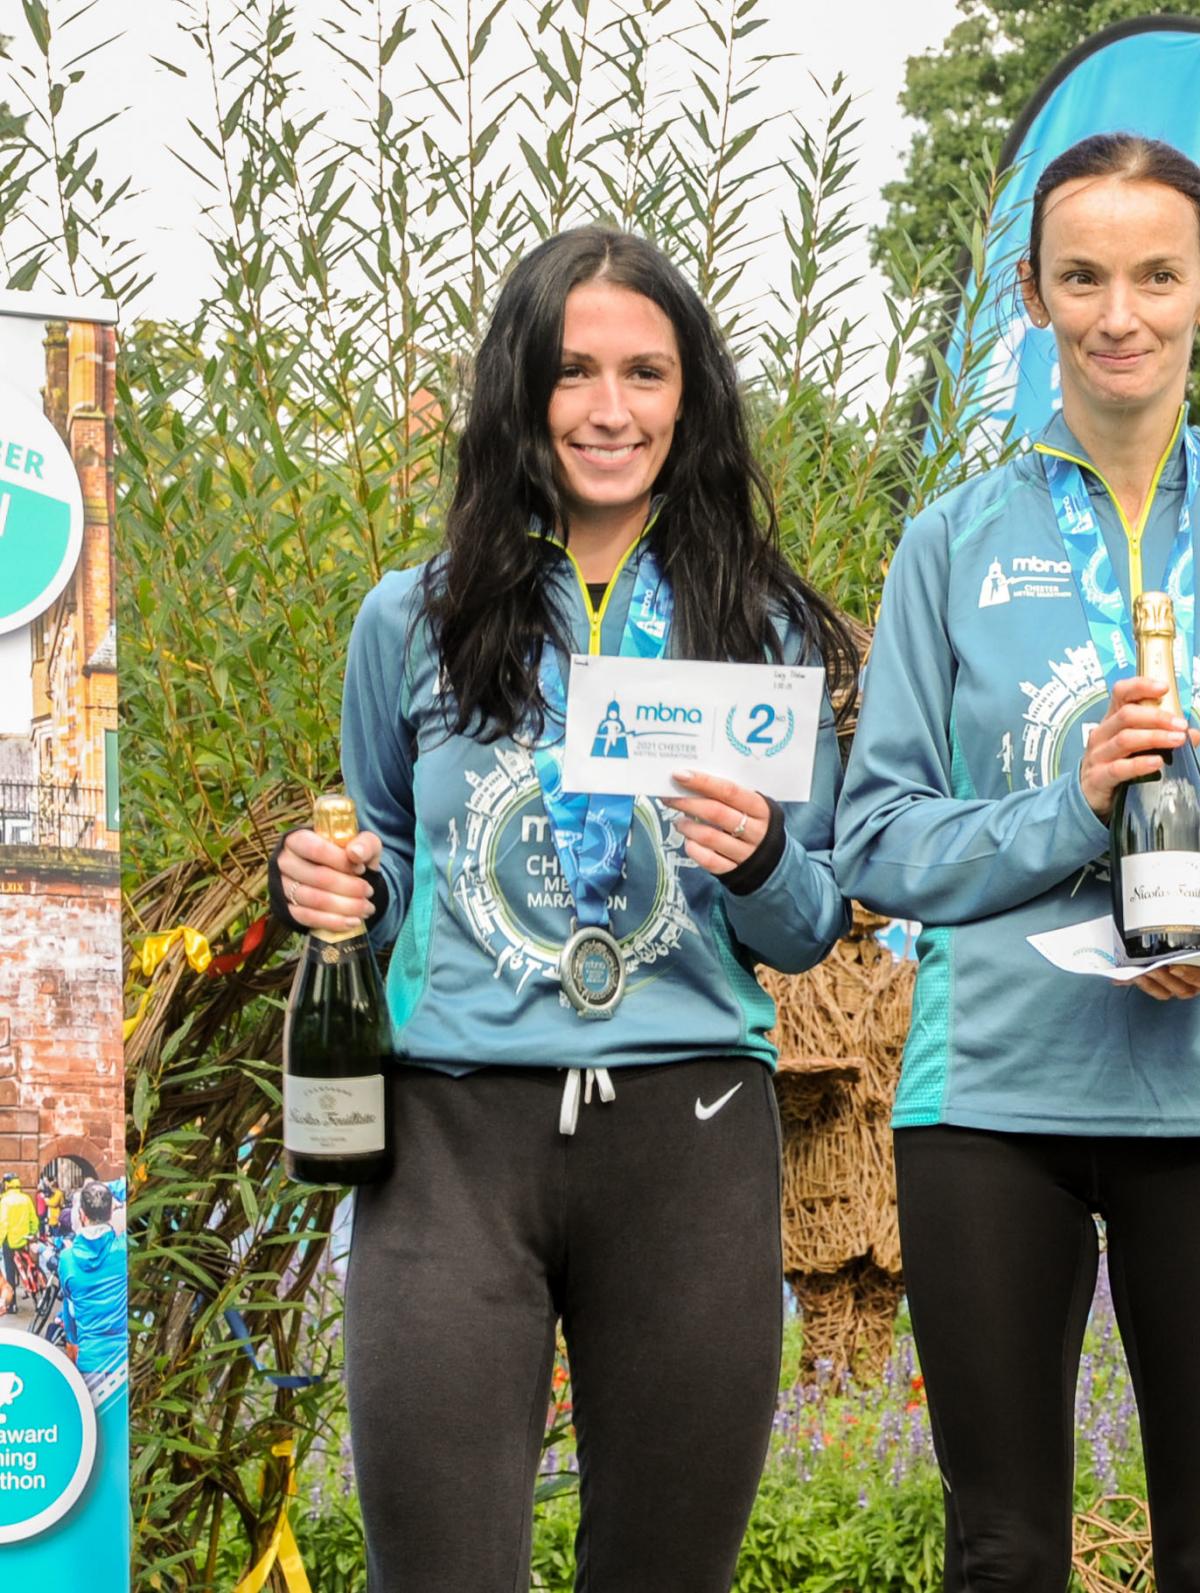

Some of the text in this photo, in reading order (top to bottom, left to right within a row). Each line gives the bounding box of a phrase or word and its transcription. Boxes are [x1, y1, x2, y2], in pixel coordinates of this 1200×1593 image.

[0, 442, 44, 480] ER
[1012, 556, 1072, 574] mbna
[636, 702, 702, 723] mbna
[746, 703, 775, 744] 2
[658, 743, 697, 753] CHESTER
[527, 892, 628, 911] MARAN
